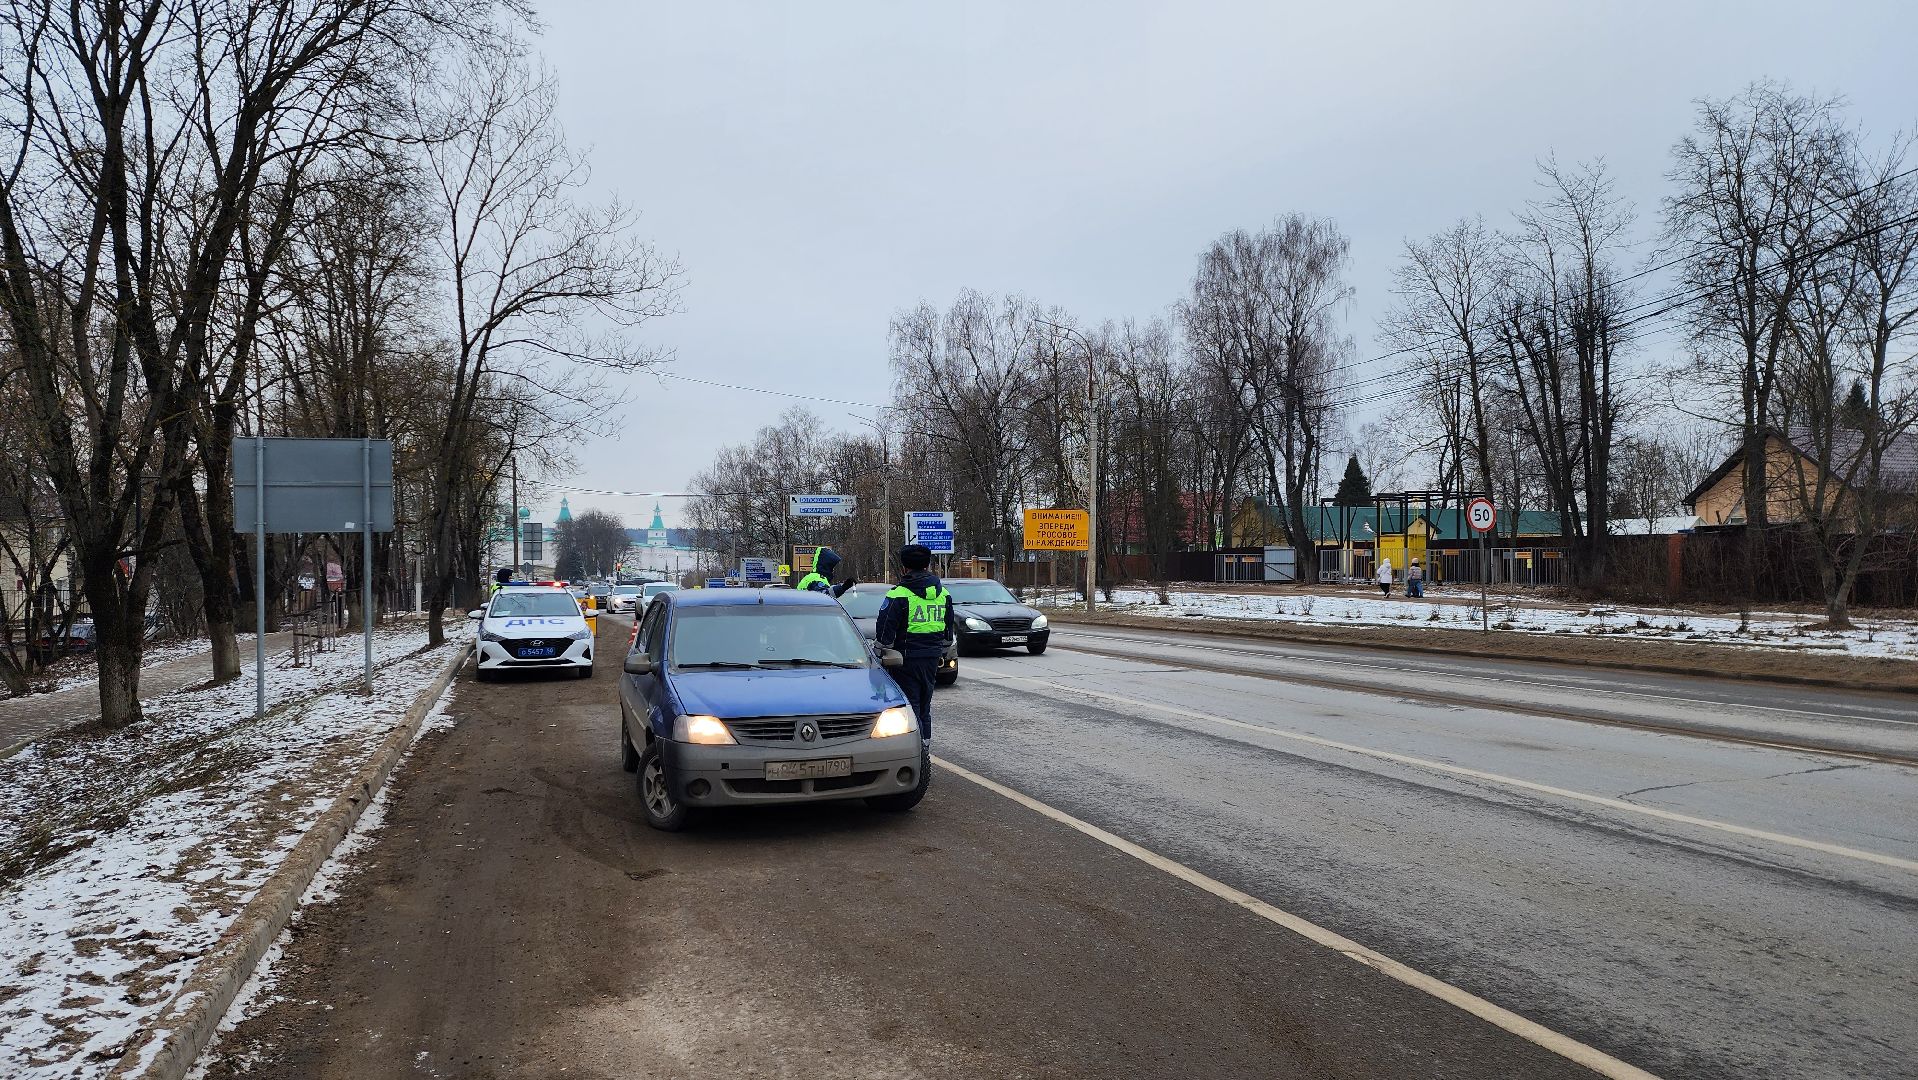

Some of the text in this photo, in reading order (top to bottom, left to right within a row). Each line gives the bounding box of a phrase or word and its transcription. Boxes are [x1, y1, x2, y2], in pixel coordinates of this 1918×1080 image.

[1031, 512, 1082, 520] ВНИМАНИЕ!!!
[1474, 508, 1490, 521] 50
[1037, 531, 1077, 539] ТРОСОВОЕ
[912, 604, 946, 622] ДПС
[505, 618, 564, 628] ДПС
